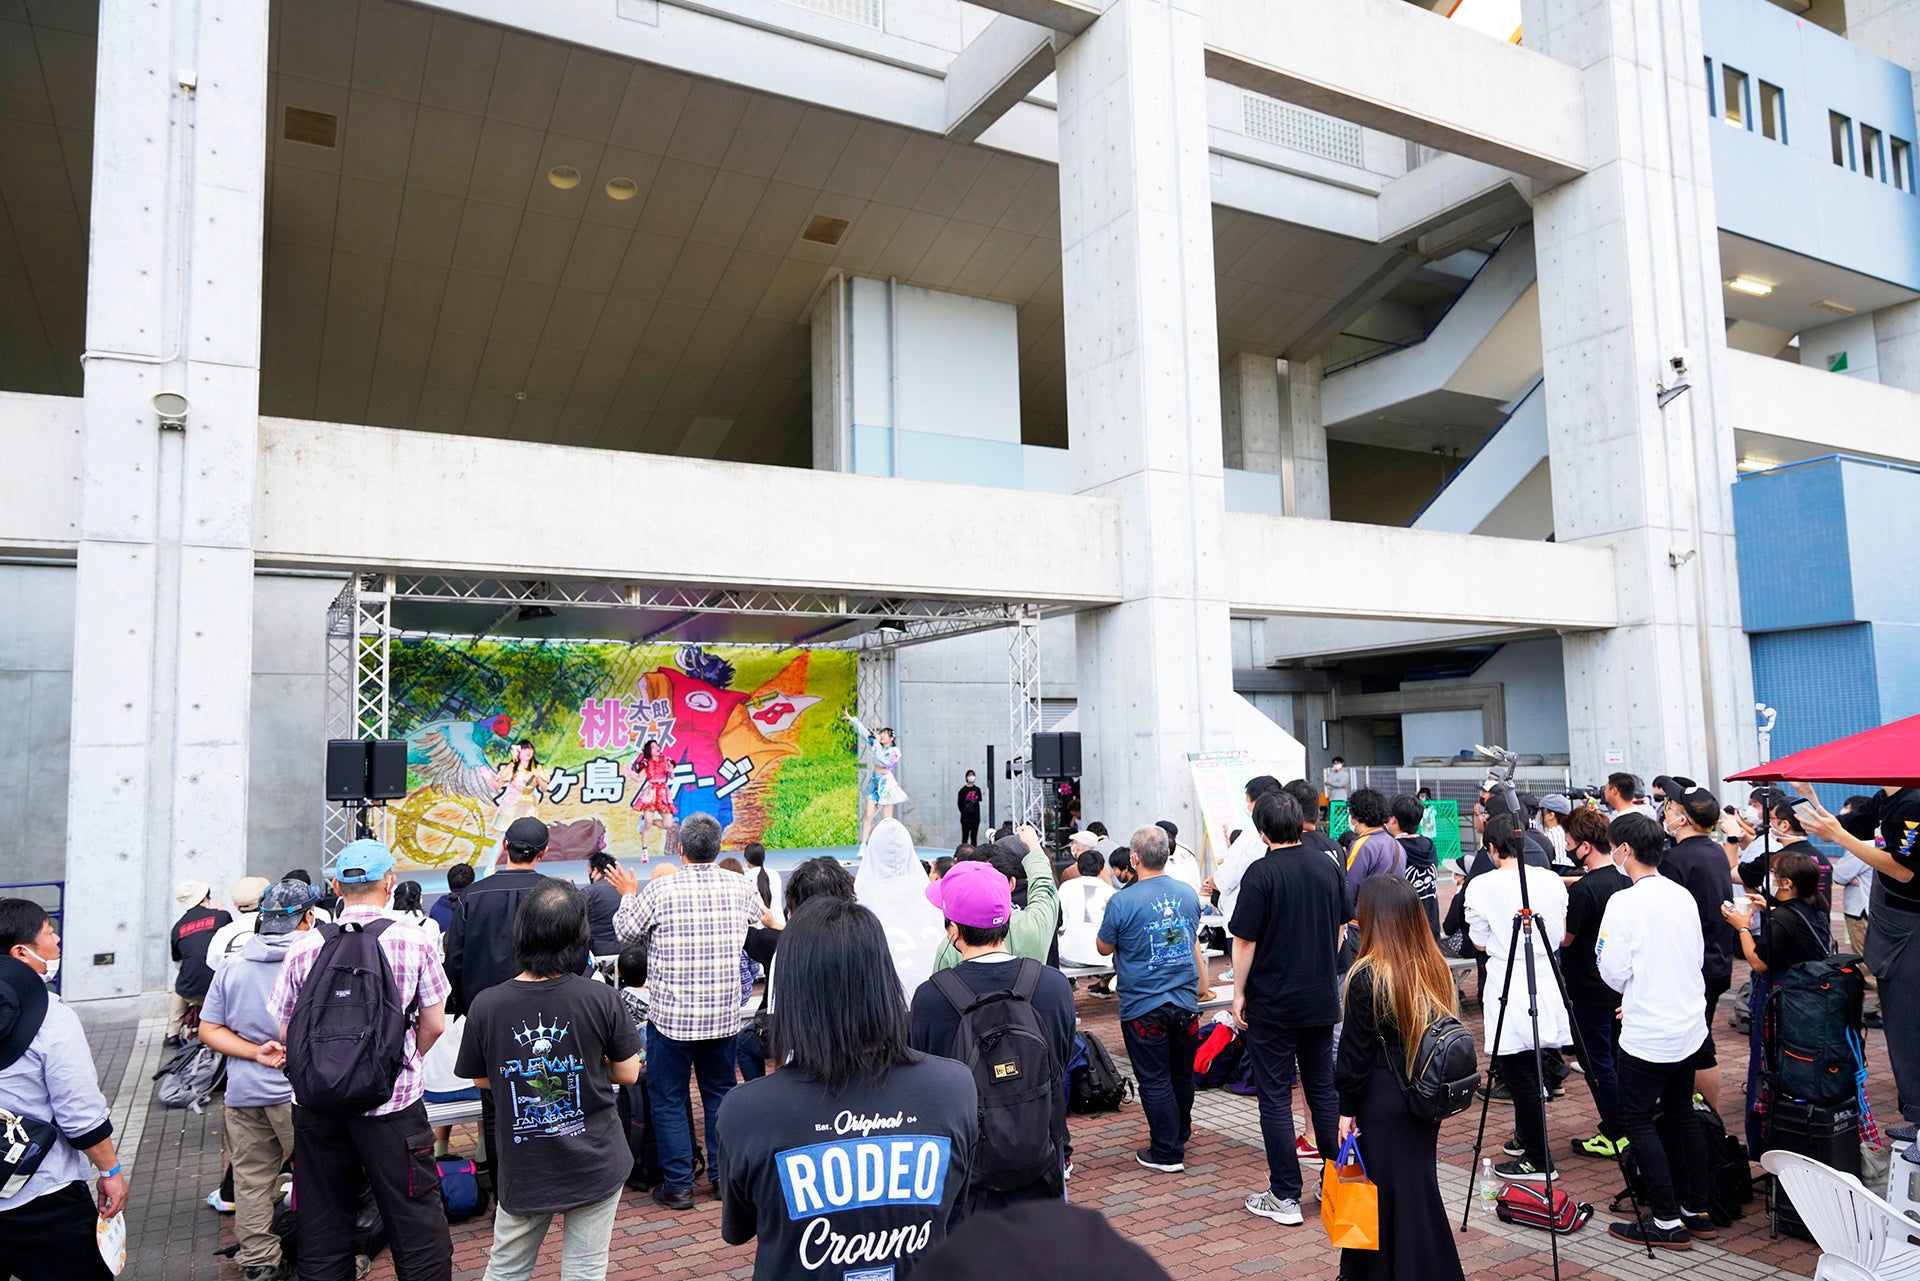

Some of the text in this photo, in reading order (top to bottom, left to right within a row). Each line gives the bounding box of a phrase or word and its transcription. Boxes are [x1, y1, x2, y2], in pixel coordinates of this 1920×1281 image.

[579, 698, 630, 750] 桃
[629, 699, 670, 722] 太郎
[815, 1123, 833, 1132] Est.
[834, 1110, 903, 1137] Original
[785, 1141, 940, 1213] RODEO
[799, 1217, 932, 1271] Crowns
